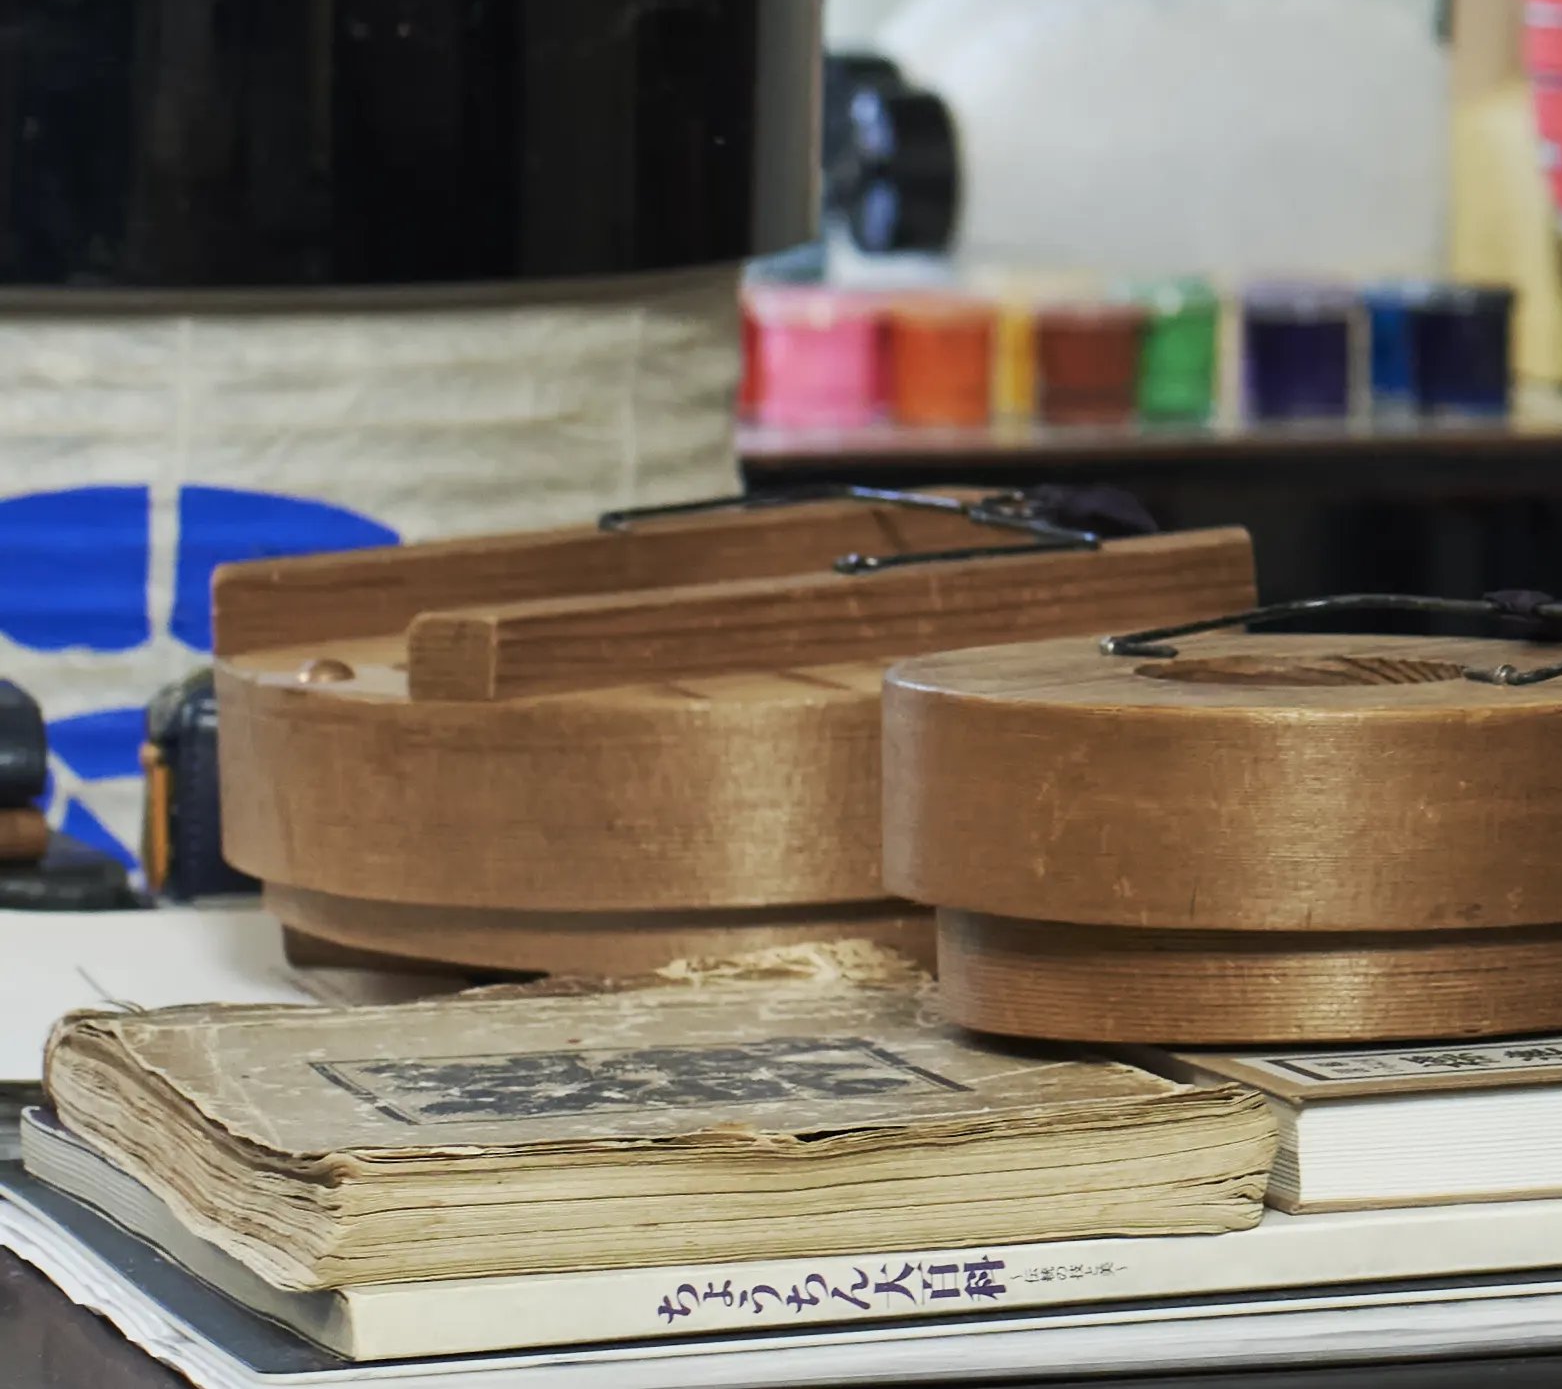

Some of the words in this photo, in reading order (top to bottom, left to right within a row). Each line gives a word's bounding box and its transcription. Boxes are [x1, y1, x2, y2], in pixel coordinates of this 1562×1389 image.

[657, 1254, 1006, 1324] ちょうちん大百科
